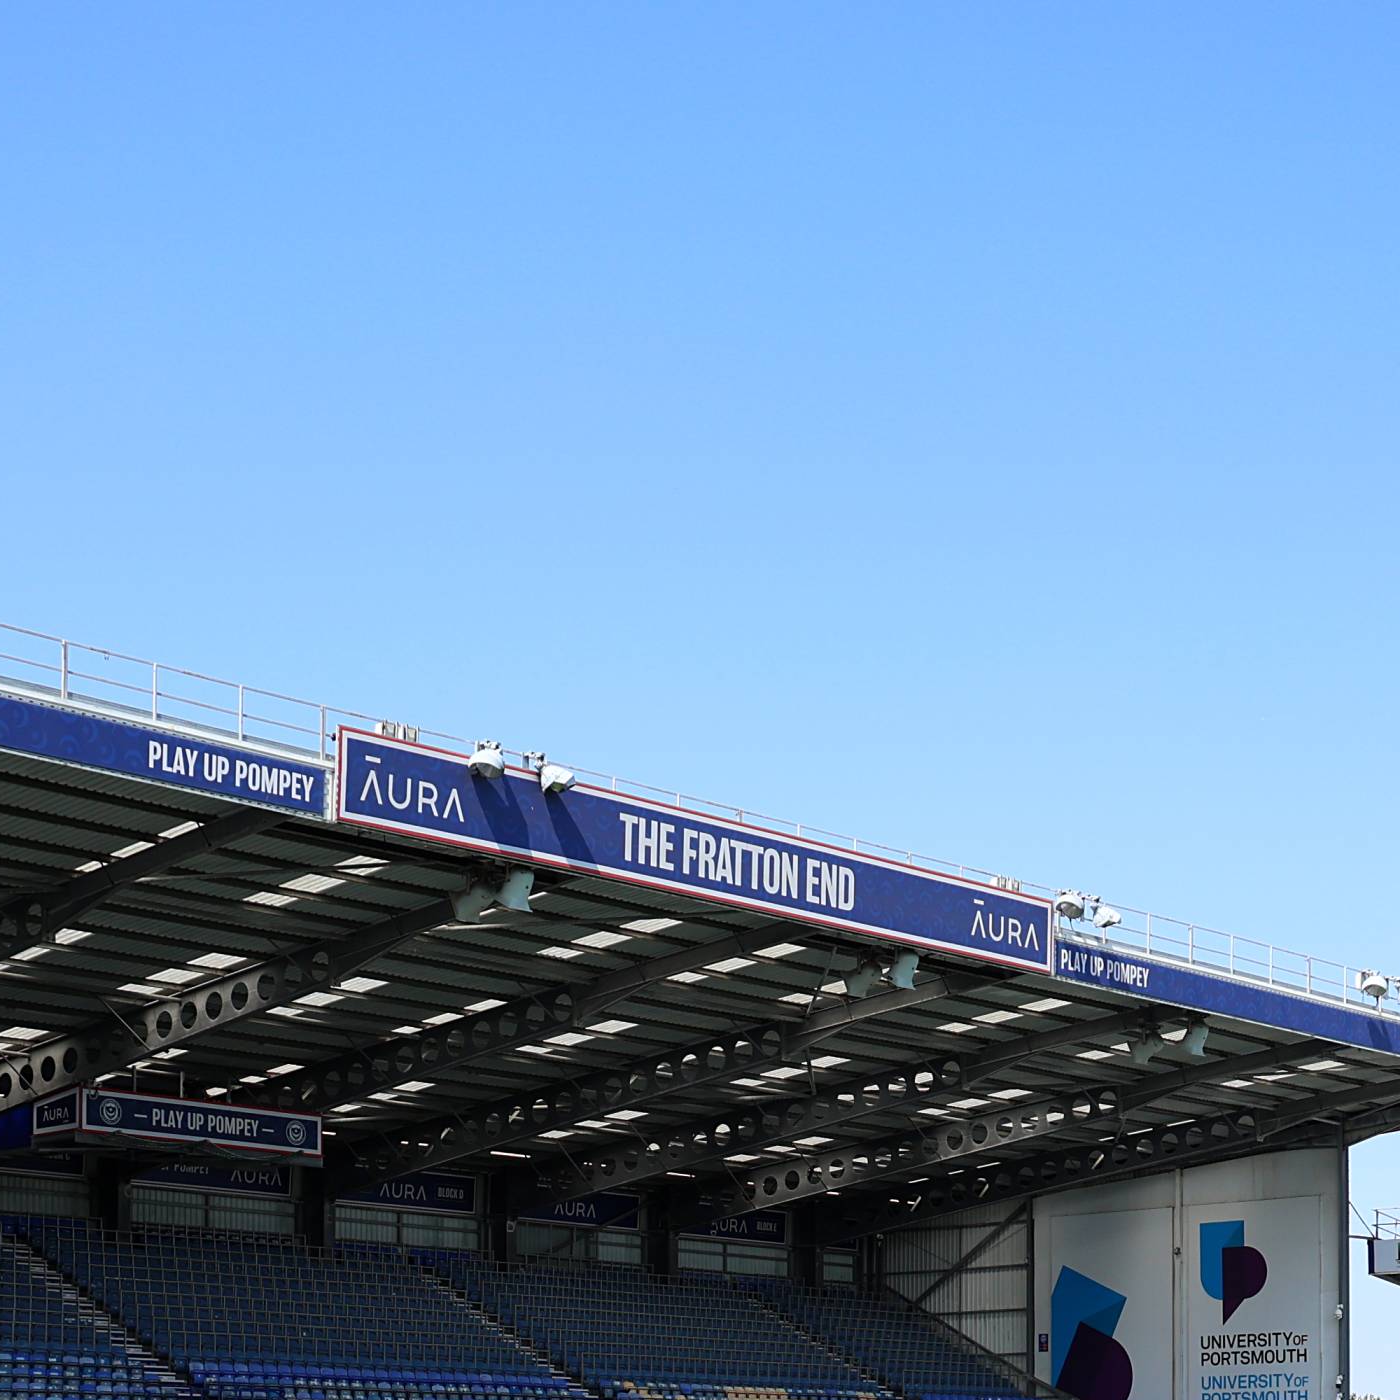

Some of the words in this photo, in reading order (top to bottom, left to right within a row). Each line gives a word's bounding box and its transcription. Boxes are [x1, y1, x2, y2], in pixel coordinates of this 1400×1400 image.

[147, 740, 197, 778] PLAY
[202, 752, 231, 784] UP
[234, 759, 314, 803] POMPEY
[619, 812, 675, 871] THE
[682, 827, 800, 900] FRATTON
[806, 858, 855, 912] END
[1060, 947, 1087, 974] PLAY
[1089, 954, 1105, 977] UP
[1106, 957, 1149, 989] POMPEY
[152, 1108, 184, 1130] PLAY
[187, 1111, 204, 1131] UP
[207, 1114, 259, 1138] POMPEY
[1200, 1332, 1292, 1349] UNIVERSITY
[1293, 1335, 1308, 1346] OF
[1201, 1348, 1307, 1366] PORTSMOUTH
[1201, 1373, 1293, 1390] UNIVERSITY
[1294, 1376, 1309, 1388] OF
